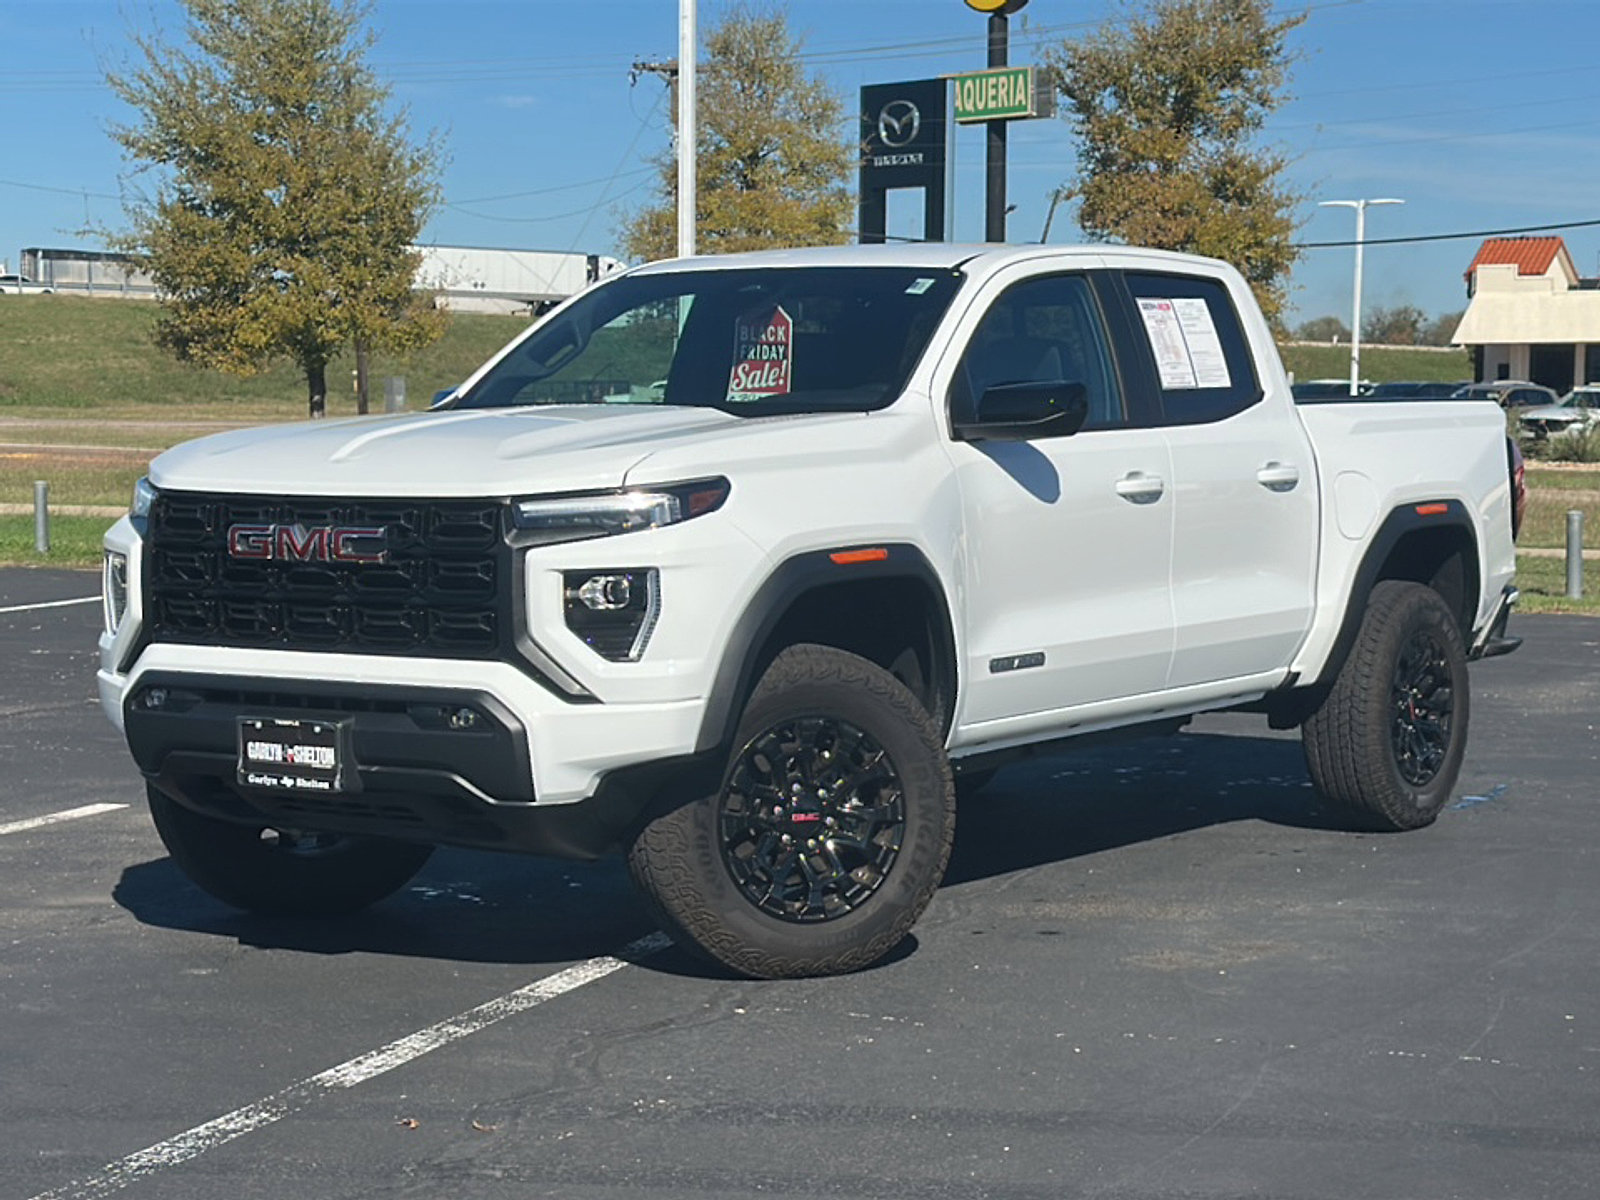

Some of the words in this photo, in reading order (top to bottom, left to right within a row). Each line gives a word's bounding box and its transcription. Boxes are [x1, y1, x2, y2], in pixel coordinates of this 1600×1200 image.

[740, 325, 787, 342] BLACK
[740, 344, 785, 360] FRIDAY
[732, 359, 788, 391] Sale!
[227, 523, 388, 563] GMC
